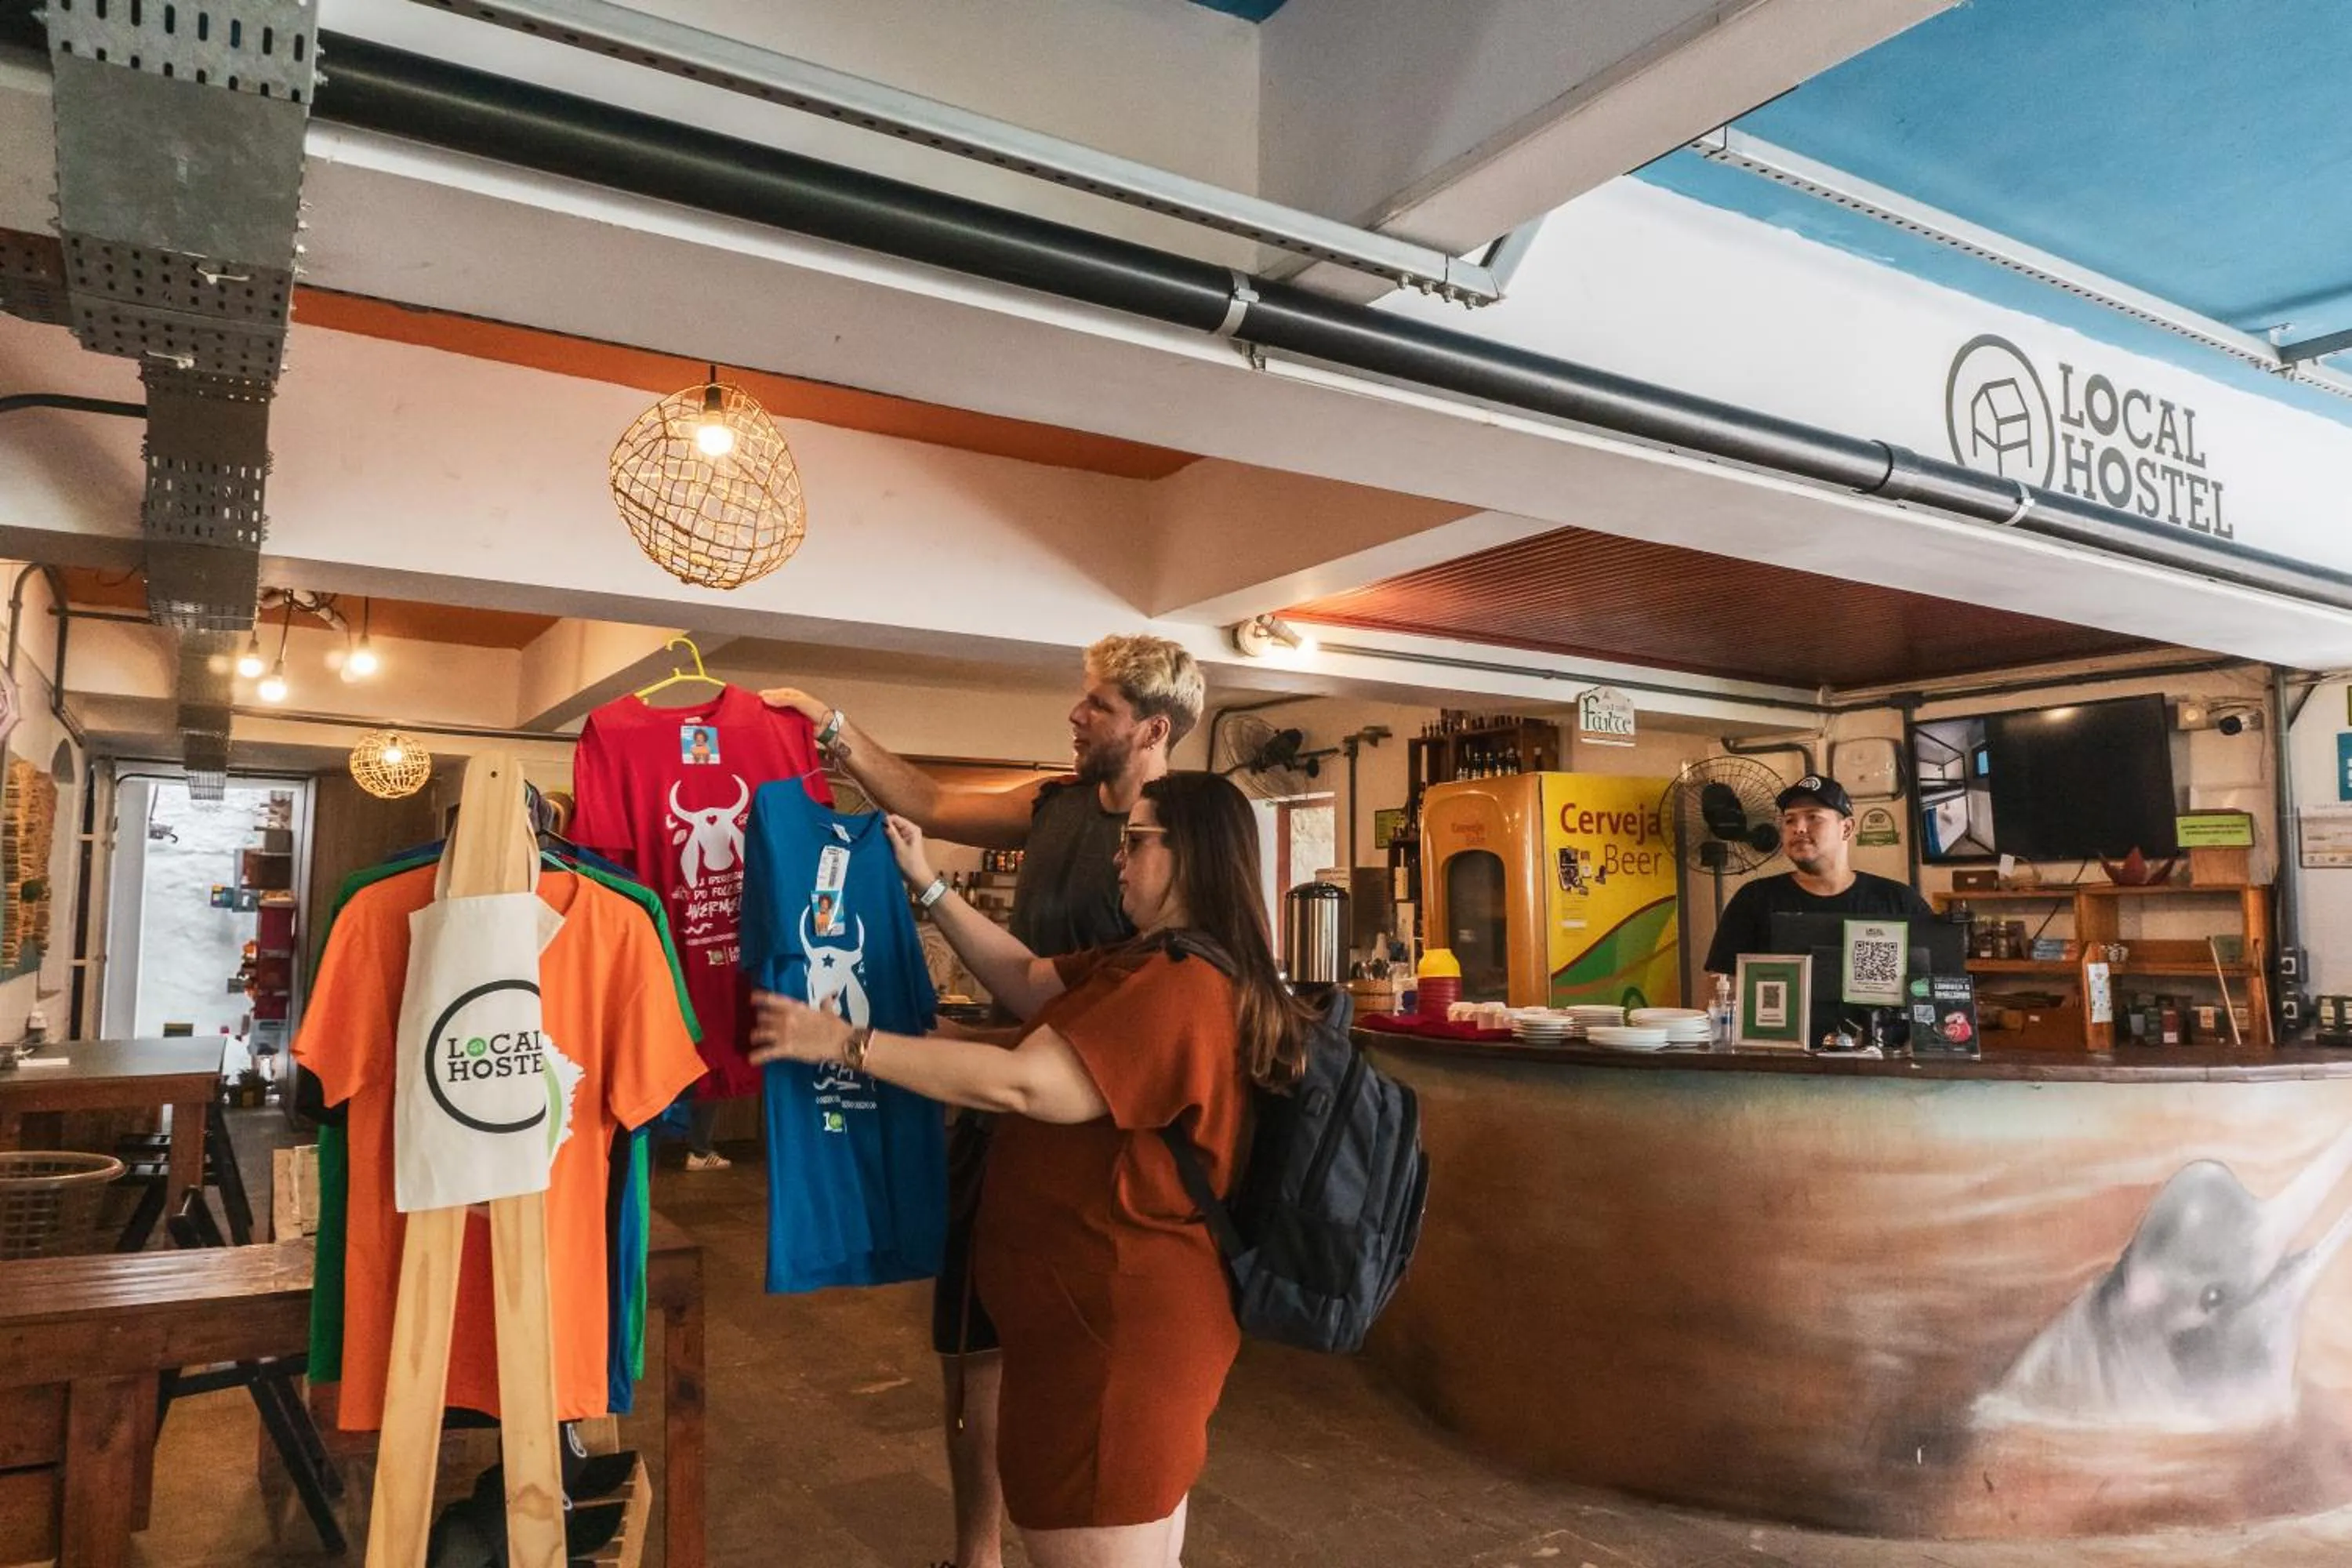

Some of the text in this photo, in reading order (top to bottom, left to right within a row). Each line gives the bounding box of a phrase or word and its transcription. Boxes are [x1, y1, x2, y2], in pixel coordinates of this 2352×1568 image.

[2058, 362, 2207, 469] LOCAL
[2061, 433, 2234, 539] HOSTEL
[1560, 802, 1659, 846] Cerveja
[1604, 844, 1663, 877] Beer
[447, 1030, 543, 1059] LOCAL
[447, 1052, 544, 1083] HOSTE
